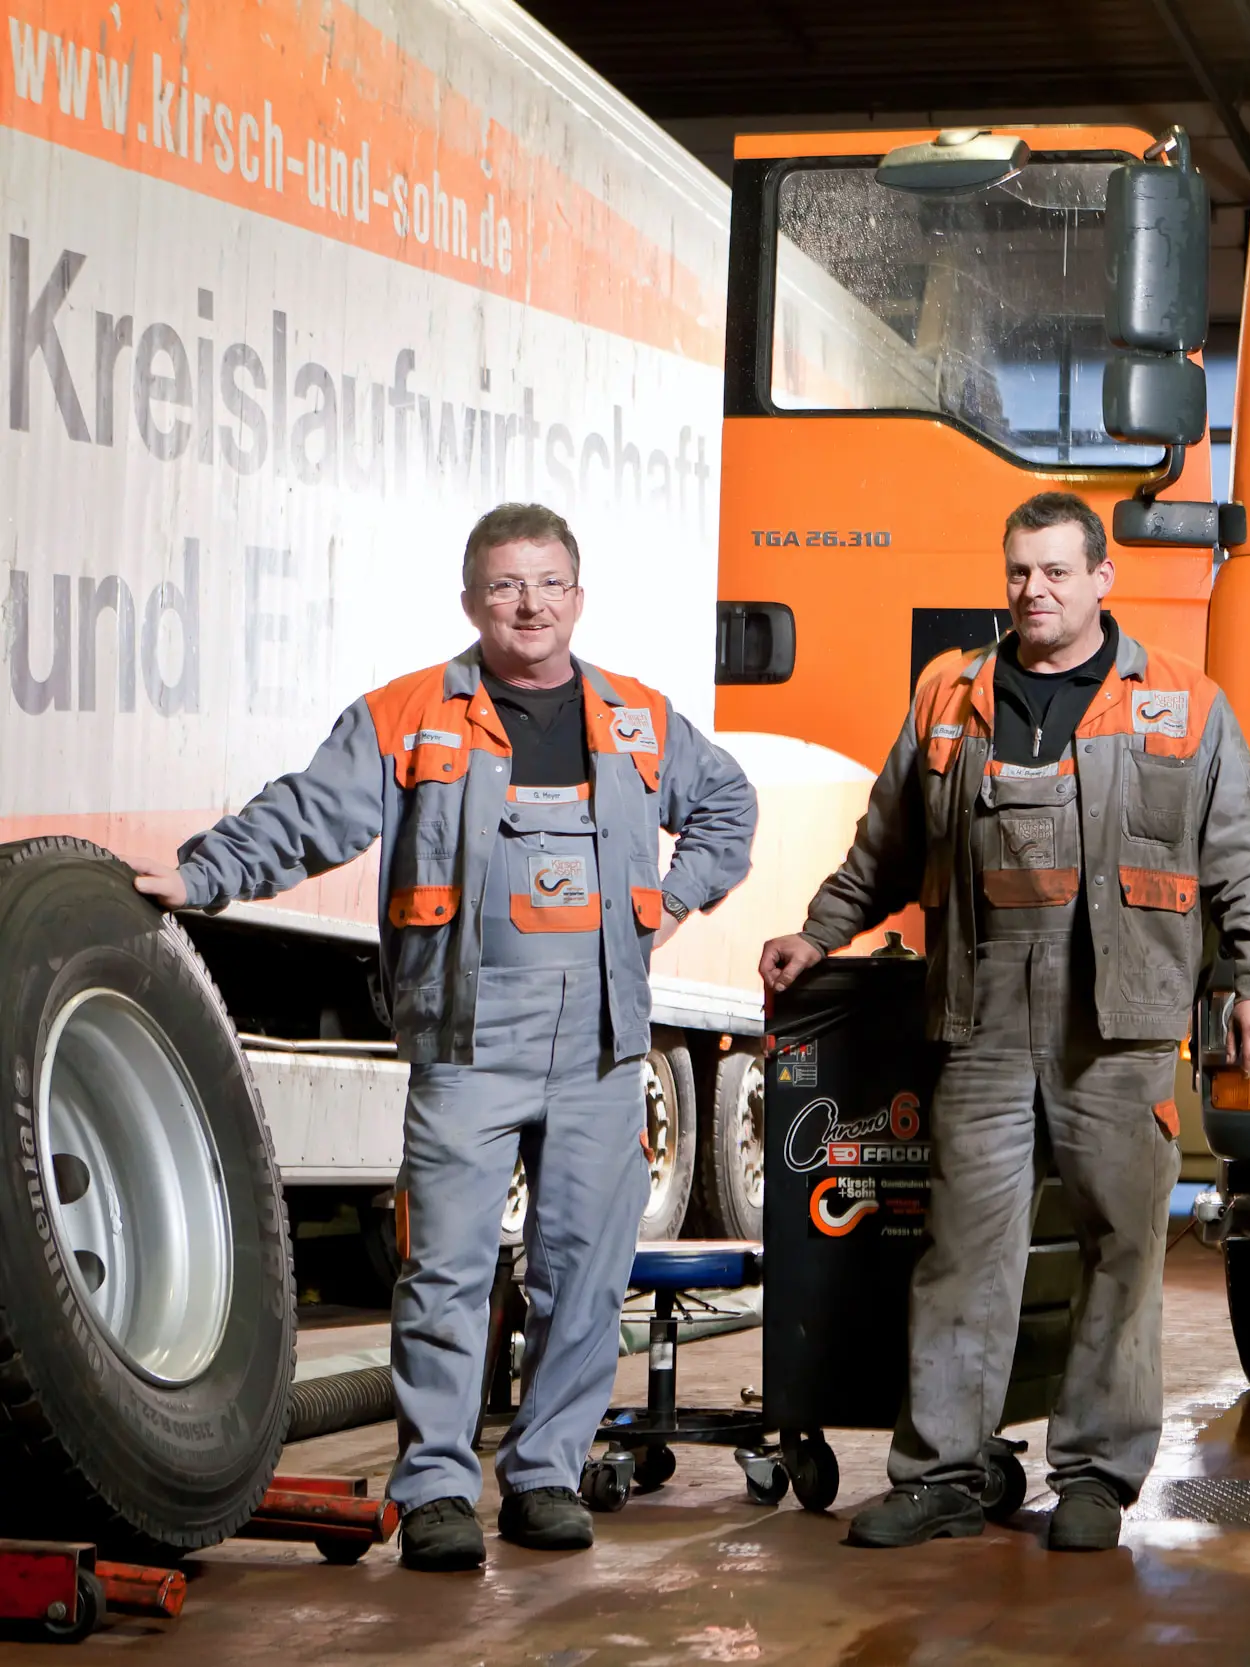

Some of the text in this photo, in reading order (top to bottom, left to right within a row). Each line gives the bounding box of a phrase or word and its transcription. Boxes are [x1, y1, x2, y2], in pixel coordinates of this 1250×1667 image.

[9, 16, 513, 274] www.kirsch-und-sohn.de
[10, 232, 711, 525] Kreislaufwirtschaft
[751, 530, 892, 547] TGA 26.310
[10, 537, 200, 718] und
[784, 1092, 921, 1173] Chrono 6
[838, 1177, 876, 1188] Kirsch
[838, 1188, 876, 1199] +Sohn
